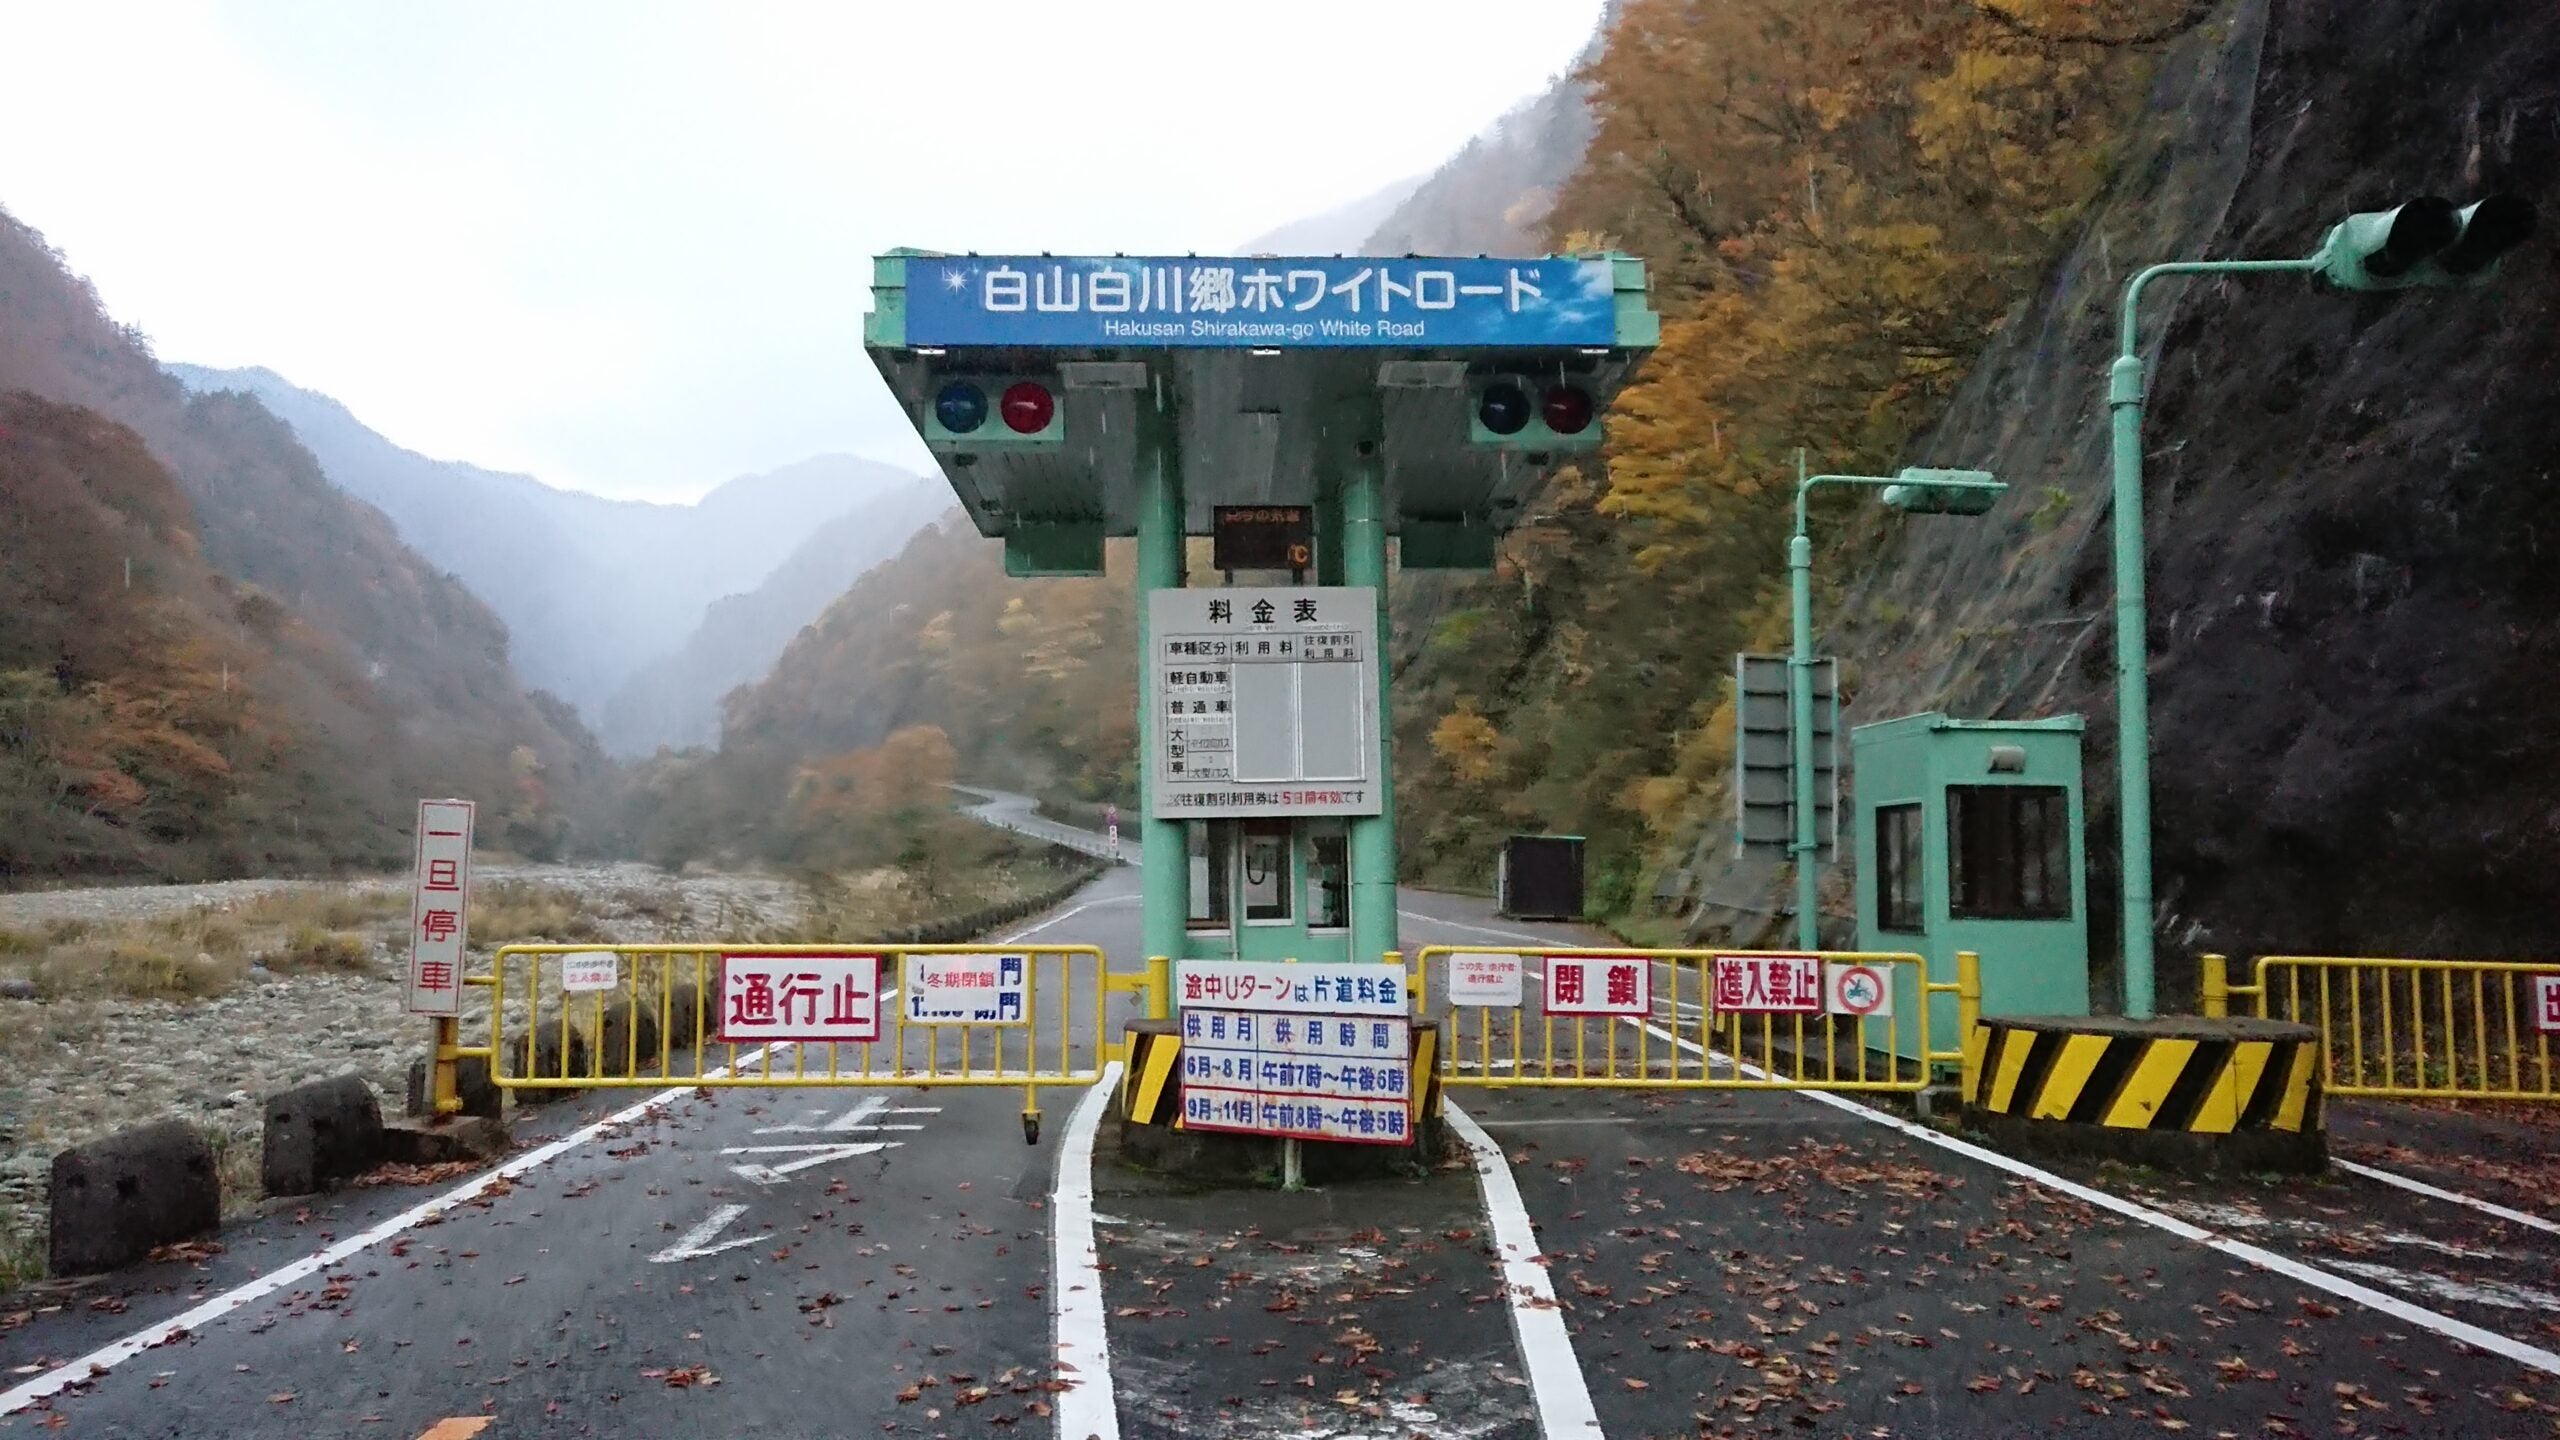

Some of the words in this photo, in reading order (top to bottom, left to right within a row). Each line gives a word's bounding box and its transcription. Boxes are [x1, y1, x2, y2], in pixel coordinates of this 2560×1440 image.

[985, 266, 1543, 314] 白山白川郷ホワイトロード
[1105, 319, 1186, 337] Hakusan
[1191, 319, 1314, 341] Shirakawa-go
[1320, 319, 1372, 337] White
[1378, 319, 1425, 337] Road
[1209, 598, 1318, 624] 料金表
[1169, 641, 1228, 656] 車種区分
[1235, 640, 1293, 655] 利用料
[1304, 635, 1354, 646] 往復割引
[1304, 648, 1354, 660] 利用料
[1169, 671, 1229, 685] 軽自動車
[1170, 700, 1229, 714] 普通車
[1170, 728, 1184, 774] 大型車
[418, 830, 462, 993] 一旦停車
[927, 971, 995, 988] 冬期閉鎖
[1184, 973, 1398, 1005] 途中Uターンは片道料金
[1555, 964, 1638, 1006] 閉鎖
[1718, 960, 1816, 1006] 進入禁止
[729, 973, 870, 1026] 通行止
[1186, 1013, 1252, 1042] 供用月
[1275, 1018, 1389, 1049] 供用時間
[1261, 1061, 1405, 1093] 午前7時～午後6時
[1261, 1103, 1405, 1136] 午前8時～午後5時
